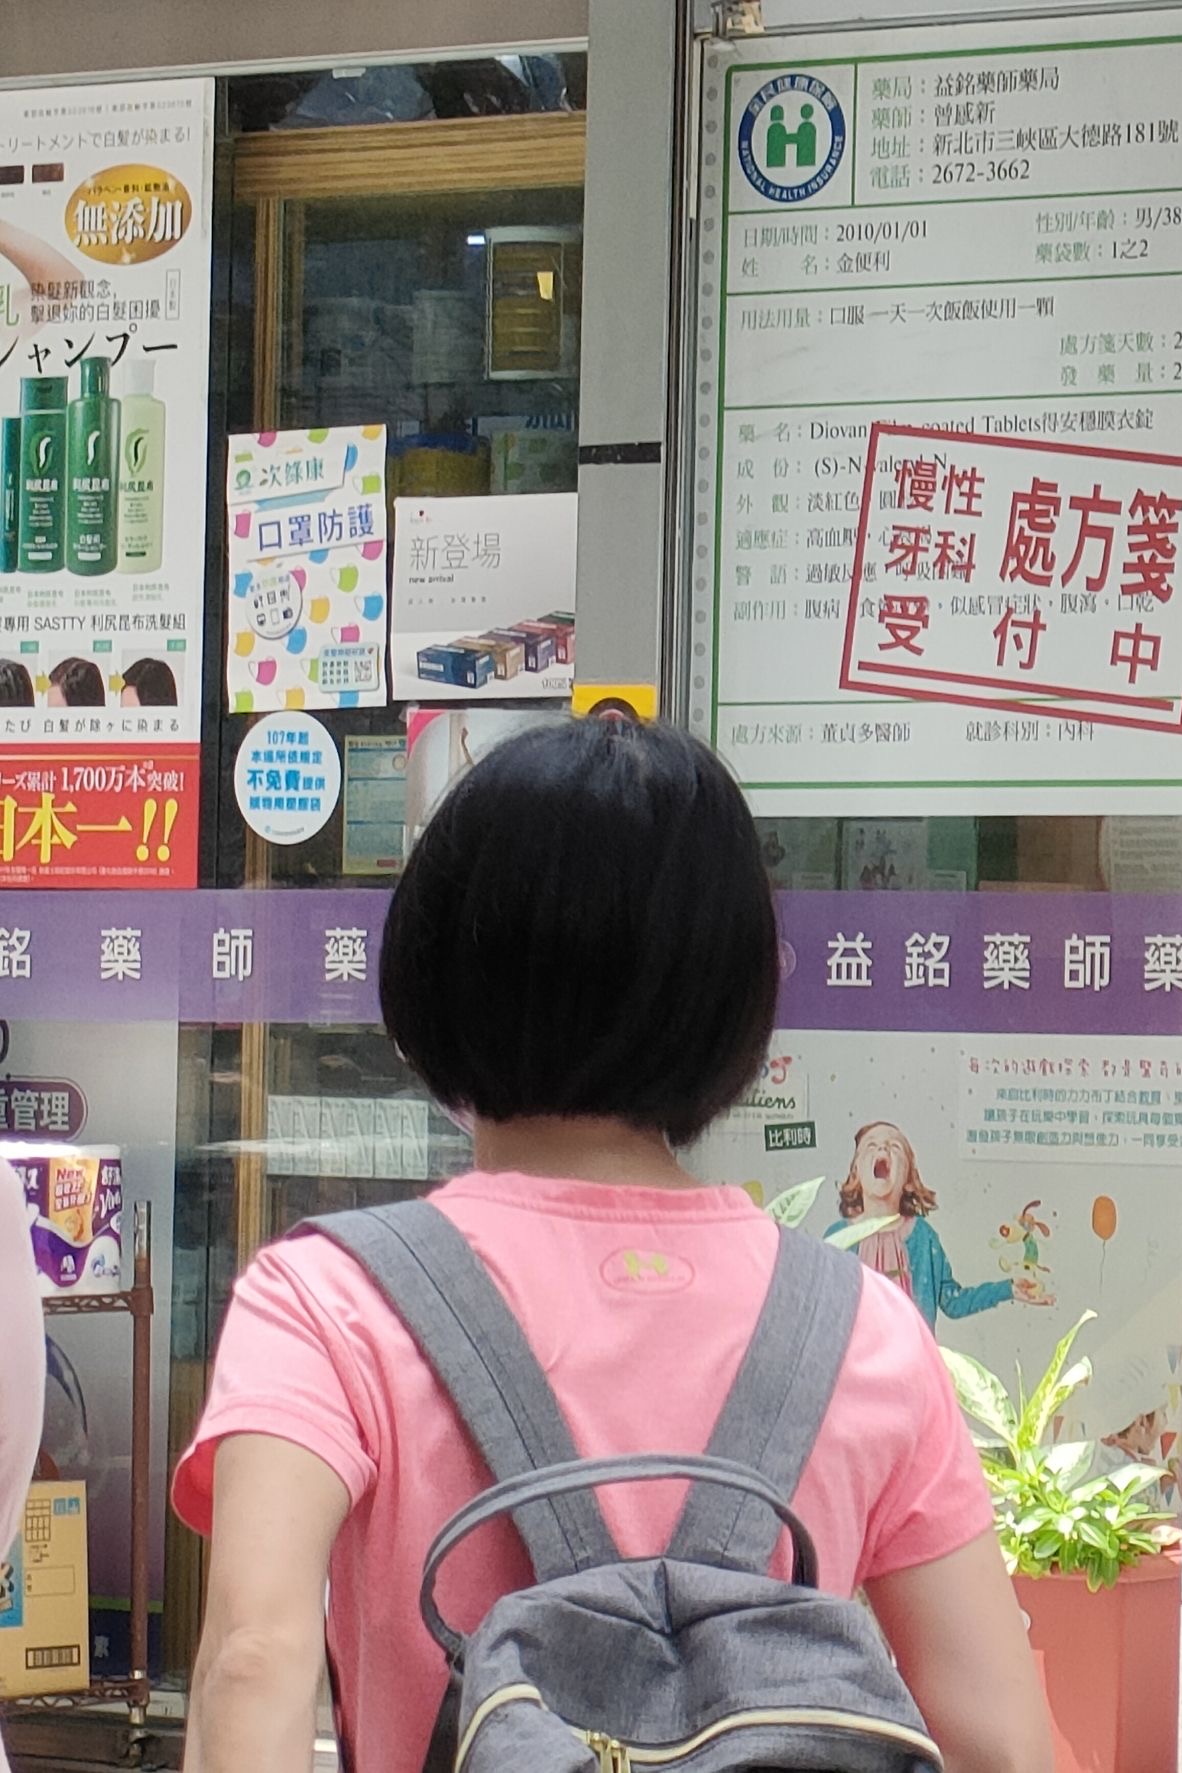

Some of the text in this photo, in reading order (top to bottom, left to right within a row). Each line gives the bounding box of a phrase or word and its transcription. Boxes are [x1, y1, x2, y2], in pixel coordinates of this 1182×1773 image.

[73, 195, 184, 247] 無添加
[260, 457, 325, 488] 次綠康
[894, 460, 985, 517] 慢性
[258, 503, 375, 551] 口罩防護
[410, 532, 501, 571] 新登場
[887, 523, 977, 582] 牙科
[0, 615, 29, 632] 專用
[34, 617, 85, 631] SASTTY
[0, 773, 57, 792] ーズ累計
[769, 1127, 812, 1147] 比利時
